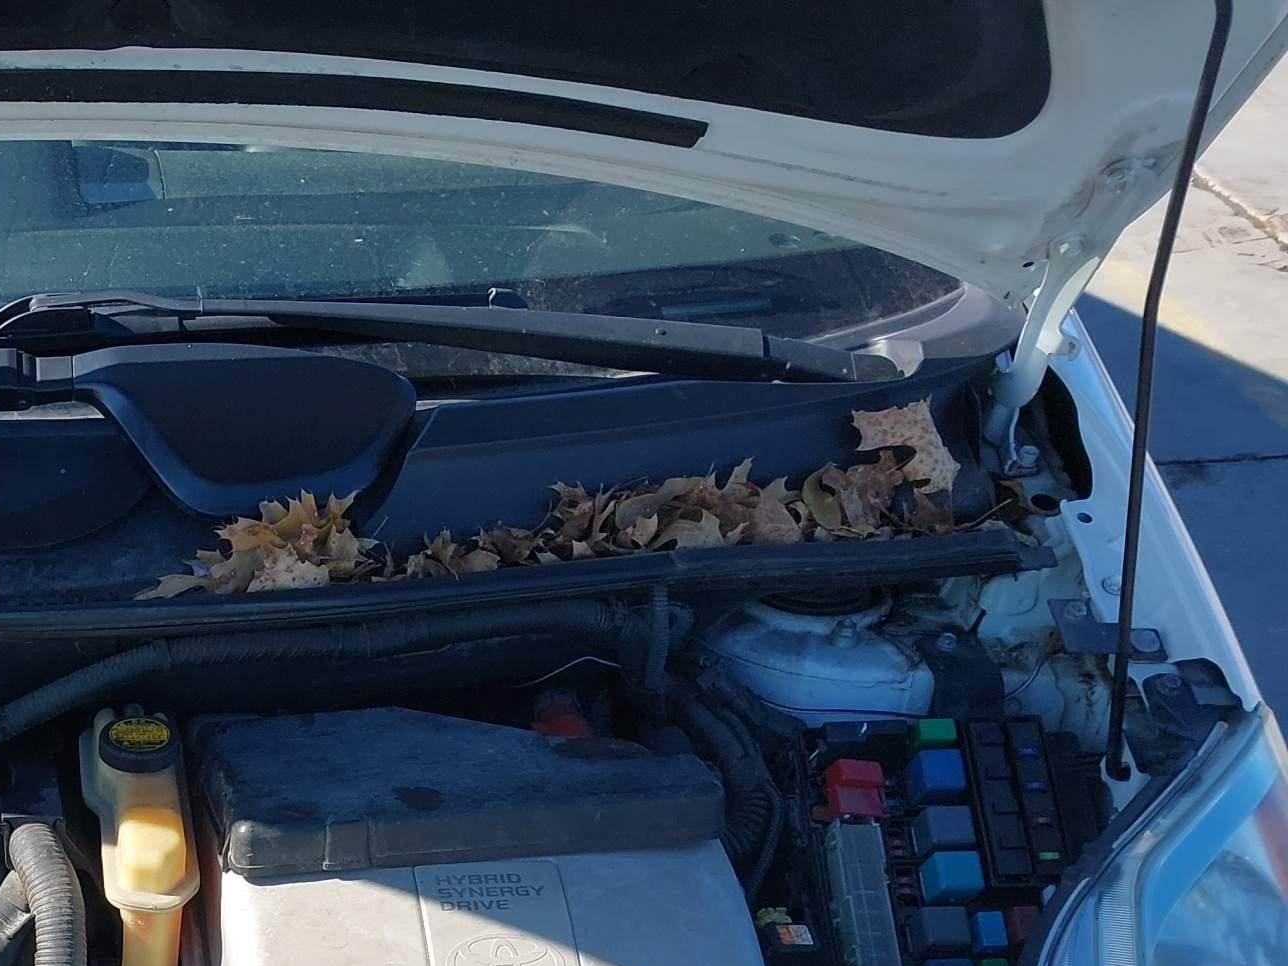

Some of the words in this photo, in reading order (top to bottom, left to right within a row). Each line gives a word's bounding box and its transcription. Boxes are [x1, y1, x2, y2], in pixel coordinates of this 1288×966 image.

[435, 873, 522, 885] HYBRID
[438, 885, 544, 898] SYNERGY
[440, 899, 510, 911] DRIVE
